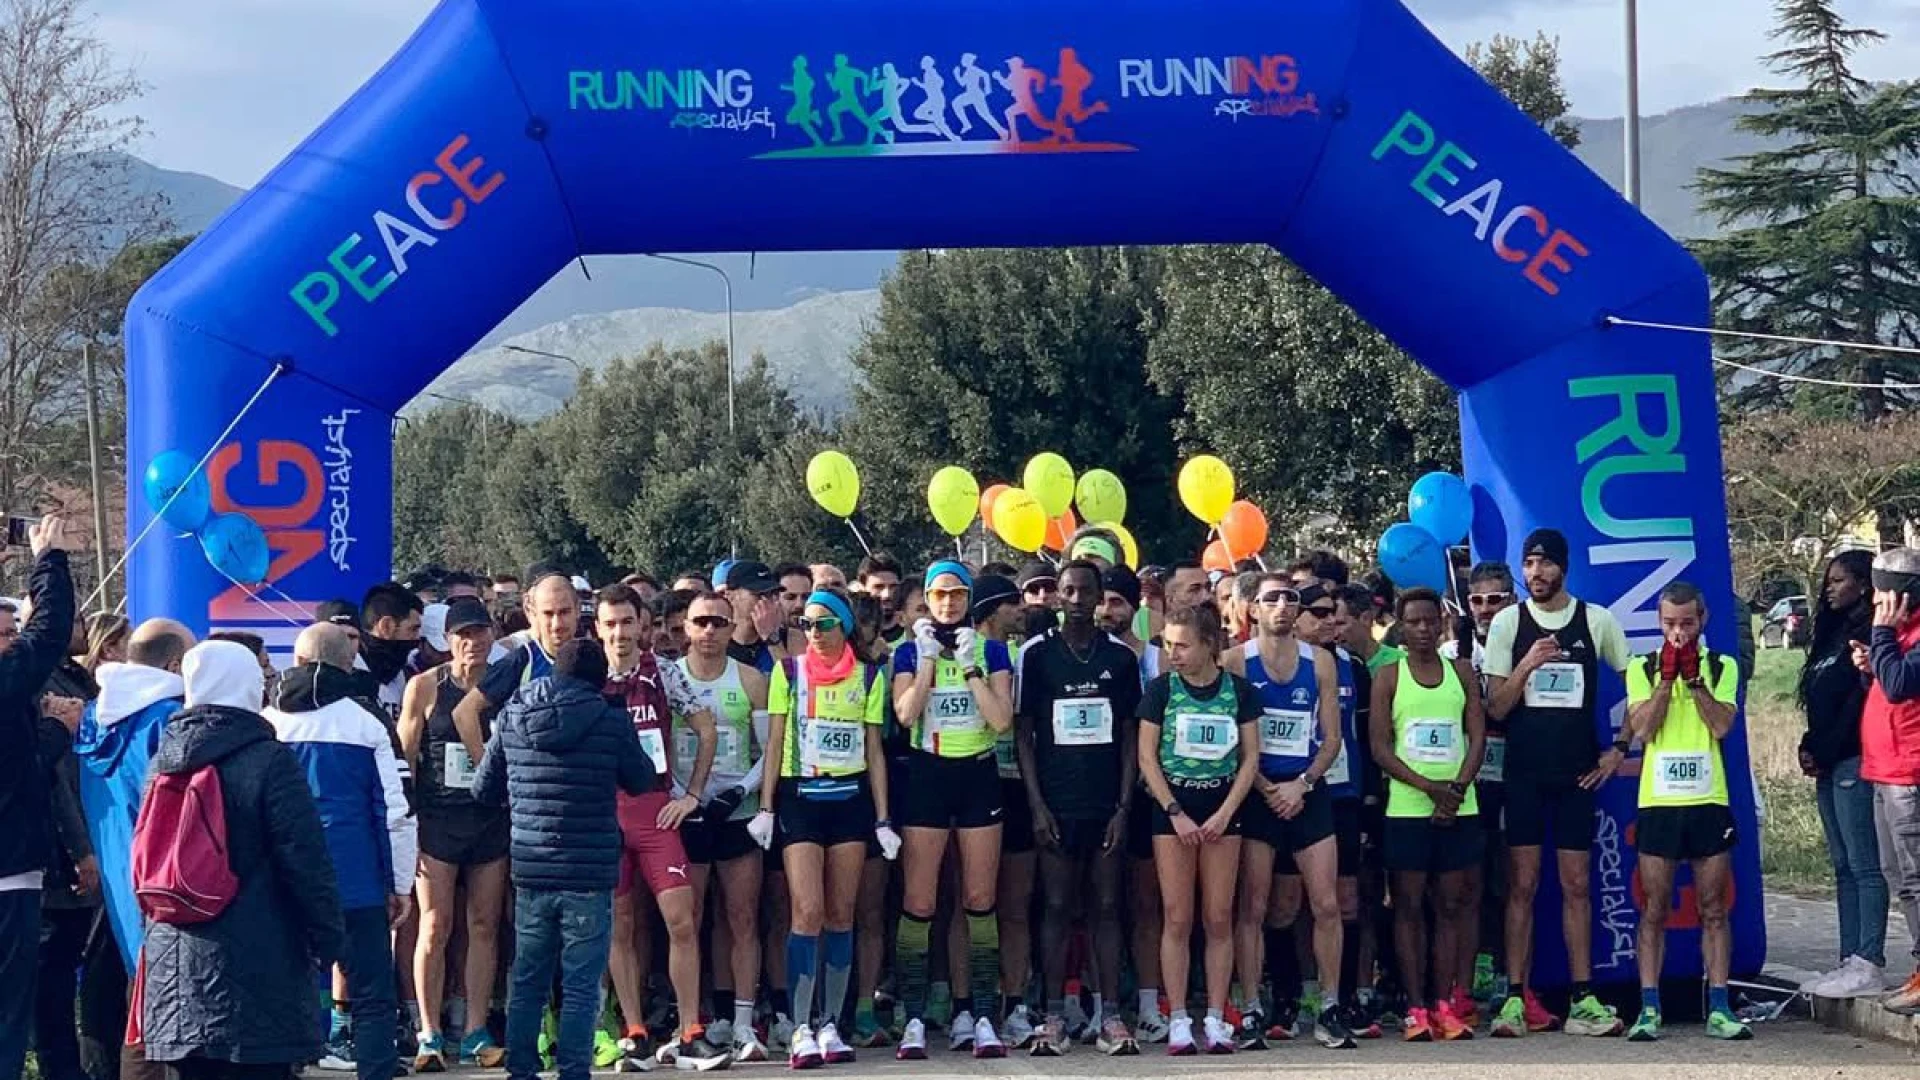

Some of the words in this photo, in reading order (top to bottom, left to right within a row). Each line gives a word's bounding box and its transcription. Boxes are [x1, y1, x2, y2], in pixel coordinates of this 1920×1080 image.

[1119, 54, 1298, 97] RUNNING
[568, 69, 752, 110] RUNNING
[1371, 110, 1588, 296] PEACE
[289, 133, 506, 337] PEACE
[1550, 673, 1559, 689] 7
[940, 697, 969, 713] 459
[626, 704, 658, 724] ZIA
[1079, 709, 1087, 726] 3
[1200, 725, 1215, 743] 10
[1268, 719, 1296, 737] 307
[822, 732, 851, 748] 458
[1430, 729, 1438, 745] 6
[1668, 762, 1697, 777] 408
[1183, 778, 1222, 790] PRO
